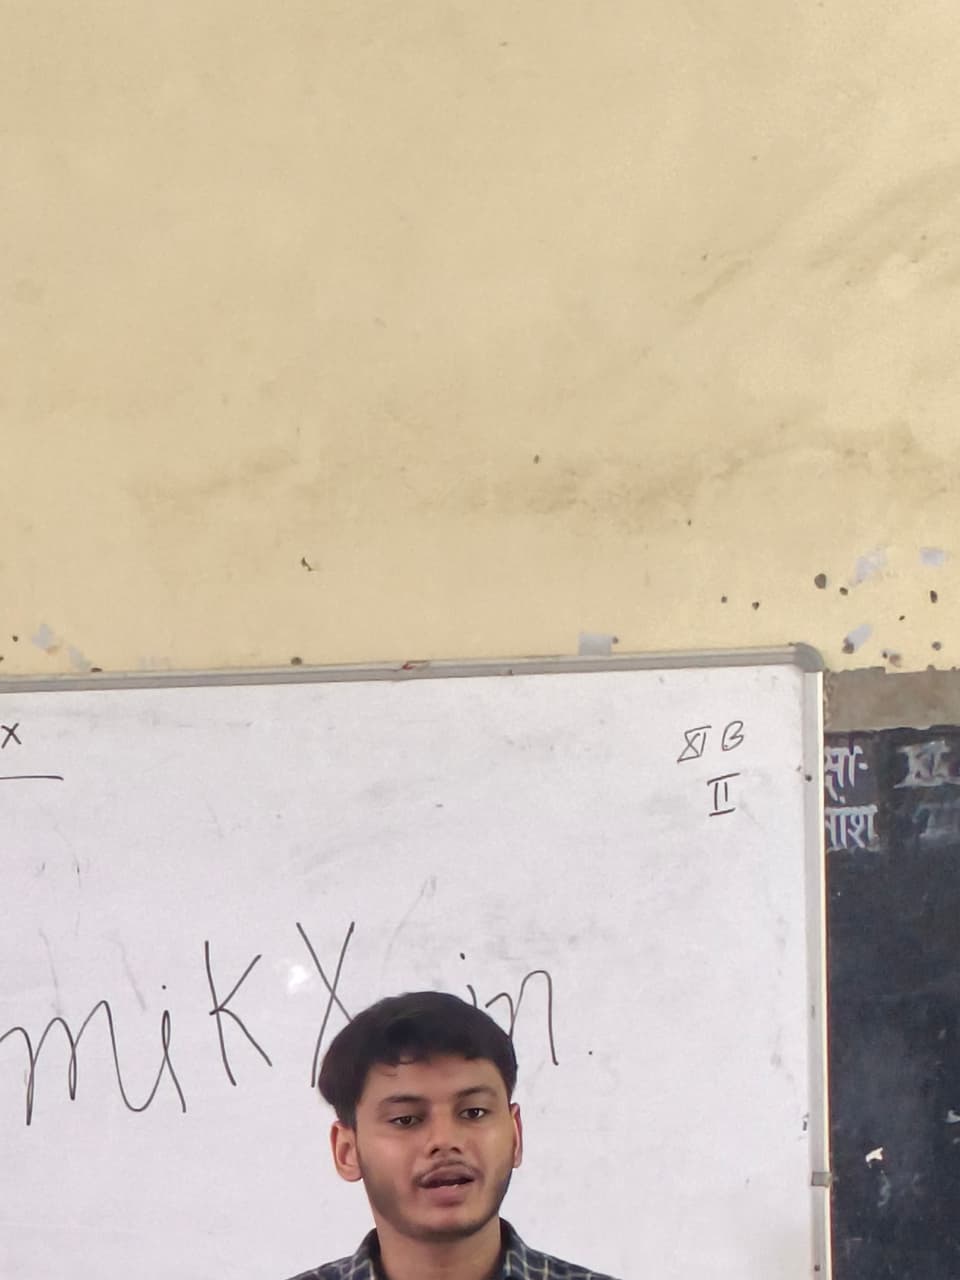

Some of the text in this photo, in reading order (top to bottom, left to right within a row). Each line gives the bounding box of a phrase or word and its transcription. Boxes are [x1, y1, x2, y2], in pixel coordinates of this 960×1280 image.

[676, 720, 745, 763] XI B
[706, 771, 742, 817] II
